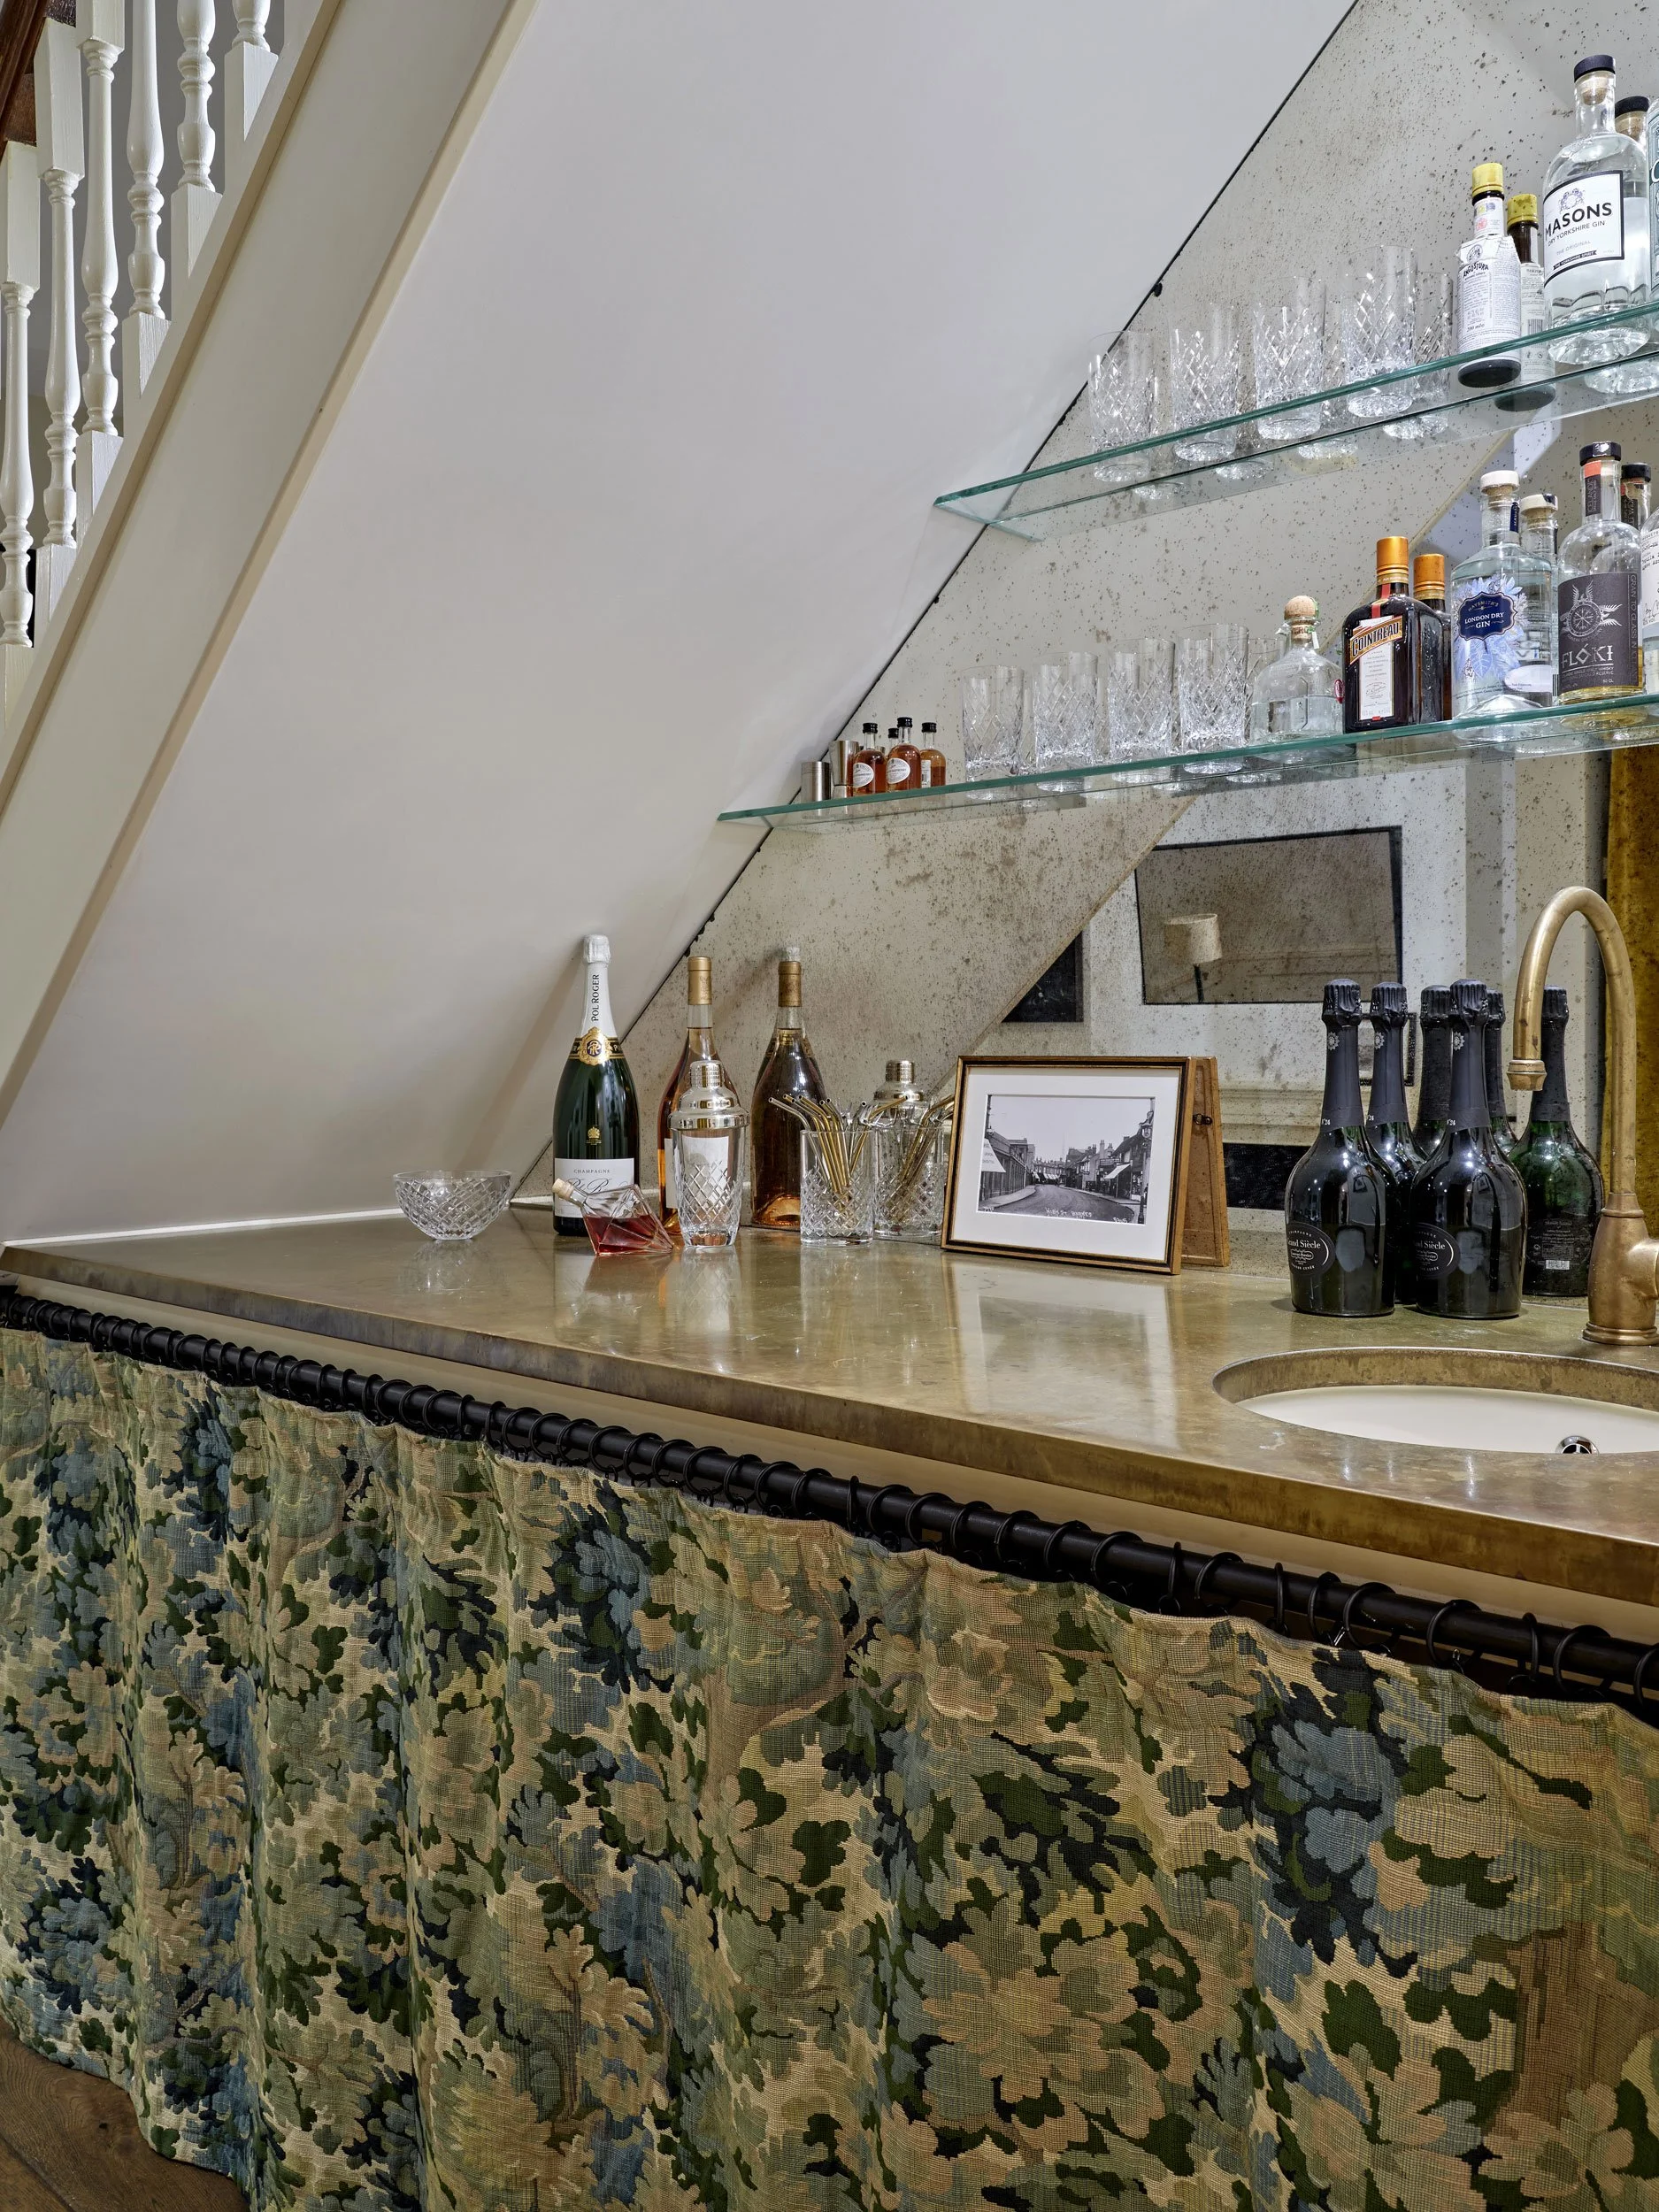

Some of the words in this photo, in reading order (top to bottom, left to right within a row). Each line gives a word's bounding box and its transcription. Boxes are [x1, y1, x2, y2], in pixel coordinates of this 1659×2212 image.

[1546, 203, 1612, 241] MASONS
[1548, 237, 1556, 247] DRY
[1556, 223, 1591, 240] YORKSHIRE
[1463, 262, 1489, 278] ANGOSTURA
[1630, 600, 1638, 611] TO
[1464, 614, 1490, 625] LONDON
[1475, 620, 1491, 629] GIN
[1351, 622, 1400, 657] COINTREAU
[1561, 643, 1614, 669] FLÓKI
[591, 974, 600, 1004] ROGER
[590, 1005, 599, 1022] POL
[1300, 1240, 1321, 1249] Siècle
[1424, 1240, 1446, 1250] Siècle
